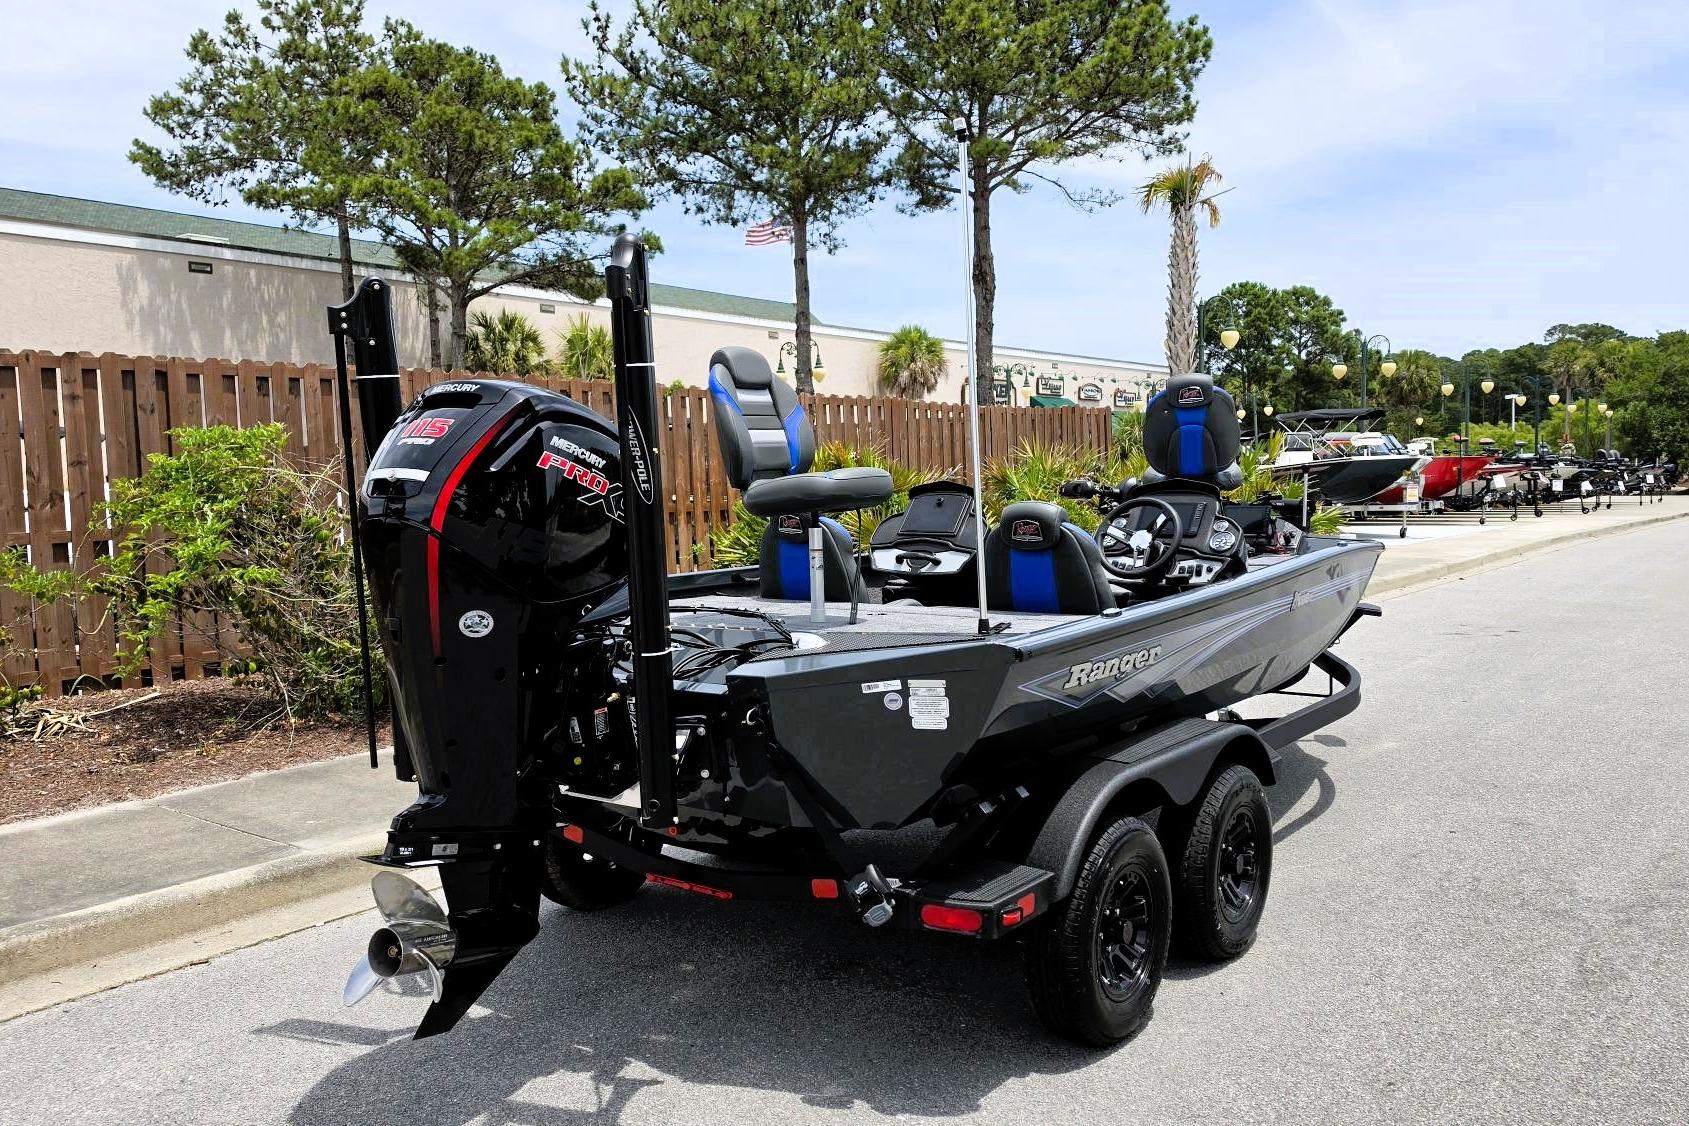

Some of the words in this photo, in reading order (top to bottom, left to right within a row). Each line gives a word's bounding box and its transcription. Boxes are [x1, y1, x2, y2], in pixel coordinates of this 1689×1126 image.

[431, 384, 480, 394] MERCURY
[401, 417, 455, 438] 115
[549, 435, 607, 469] MERCURY
[628, 414, 651, 491] WER-POLE
[536, 450, 610, 495] PRO
[1063, 644, 1162, 689] Ranger
